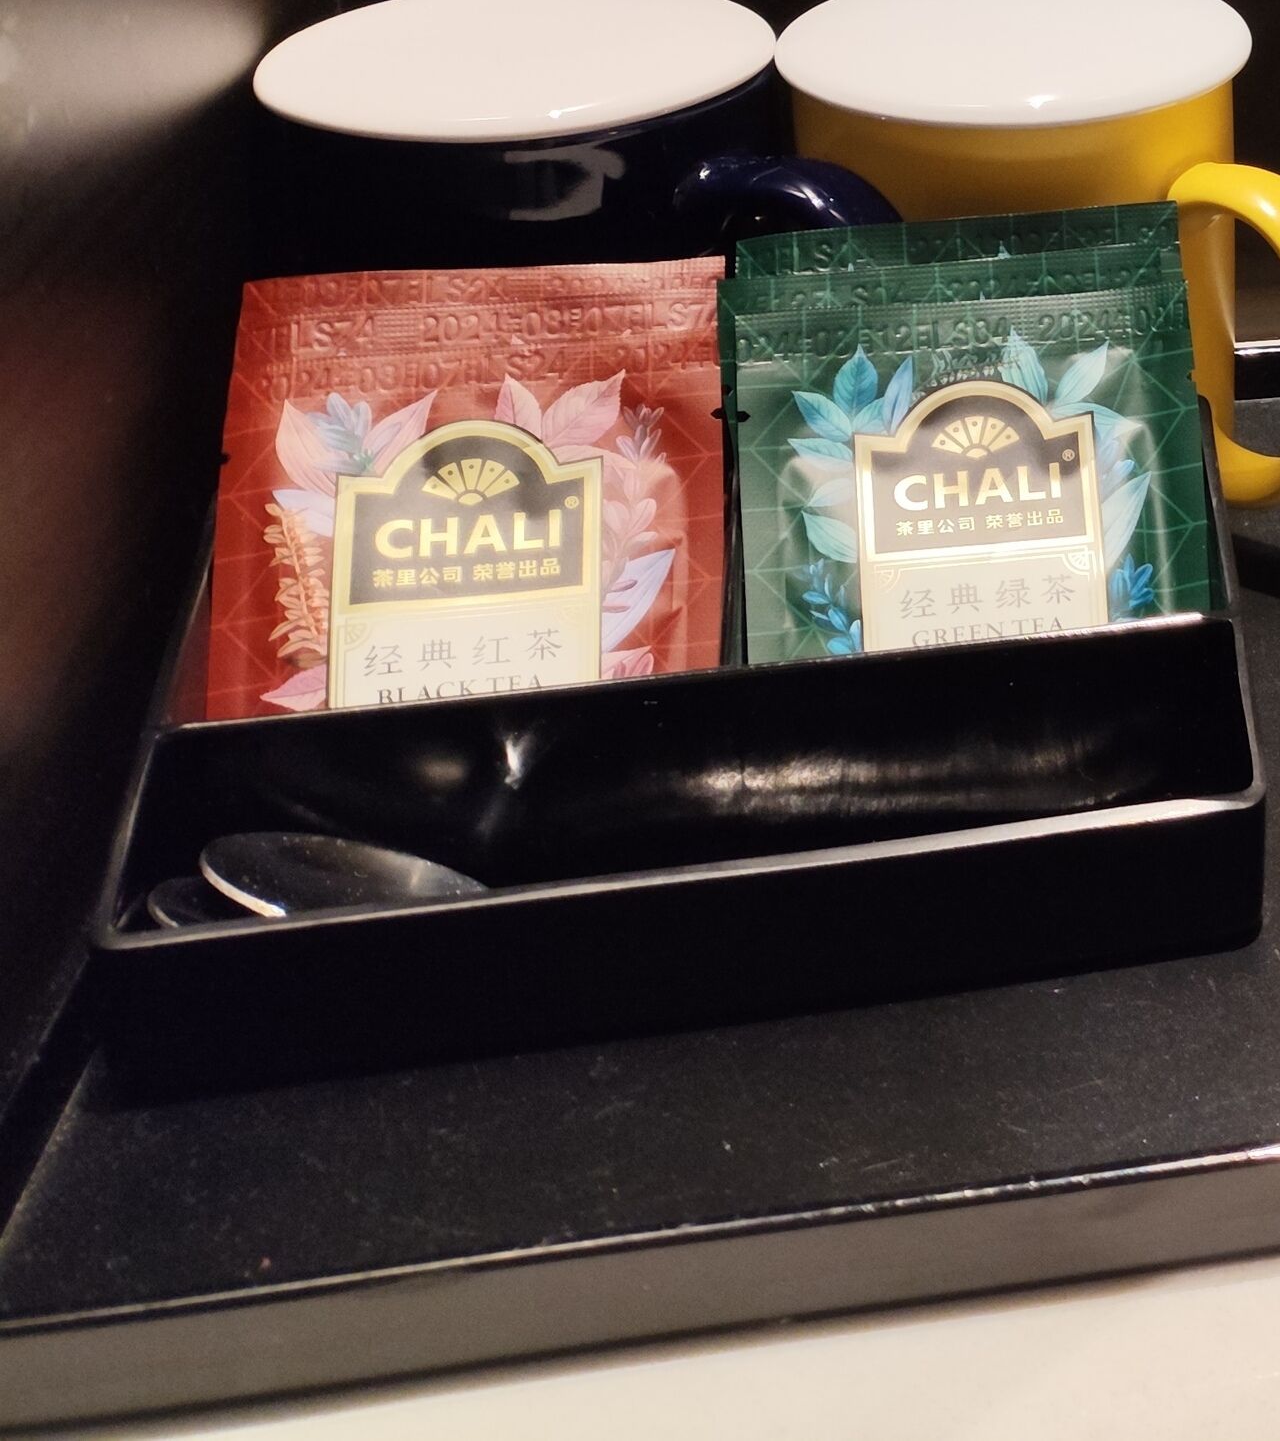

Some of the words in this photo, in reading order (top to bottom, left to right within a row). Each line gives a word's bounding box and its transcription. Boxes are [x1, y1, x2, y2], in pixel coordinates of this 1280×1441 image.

[894, 462, 1062, 511] CHALI
[375, 509, 562, 559] CHALI
[895, 516, 976, 537] 茶里公司
[985, 508, 1064, 530] 荣誉出品
[372, 565, 463, 588] 茶里公司
[472, 558, 561, 582] 荣誉出品
[900, 573, 1076, 620] 经典绿茶
[363, 627, 562, 677] 经典红茶
[911, 620, 1003, 648] GREEN
